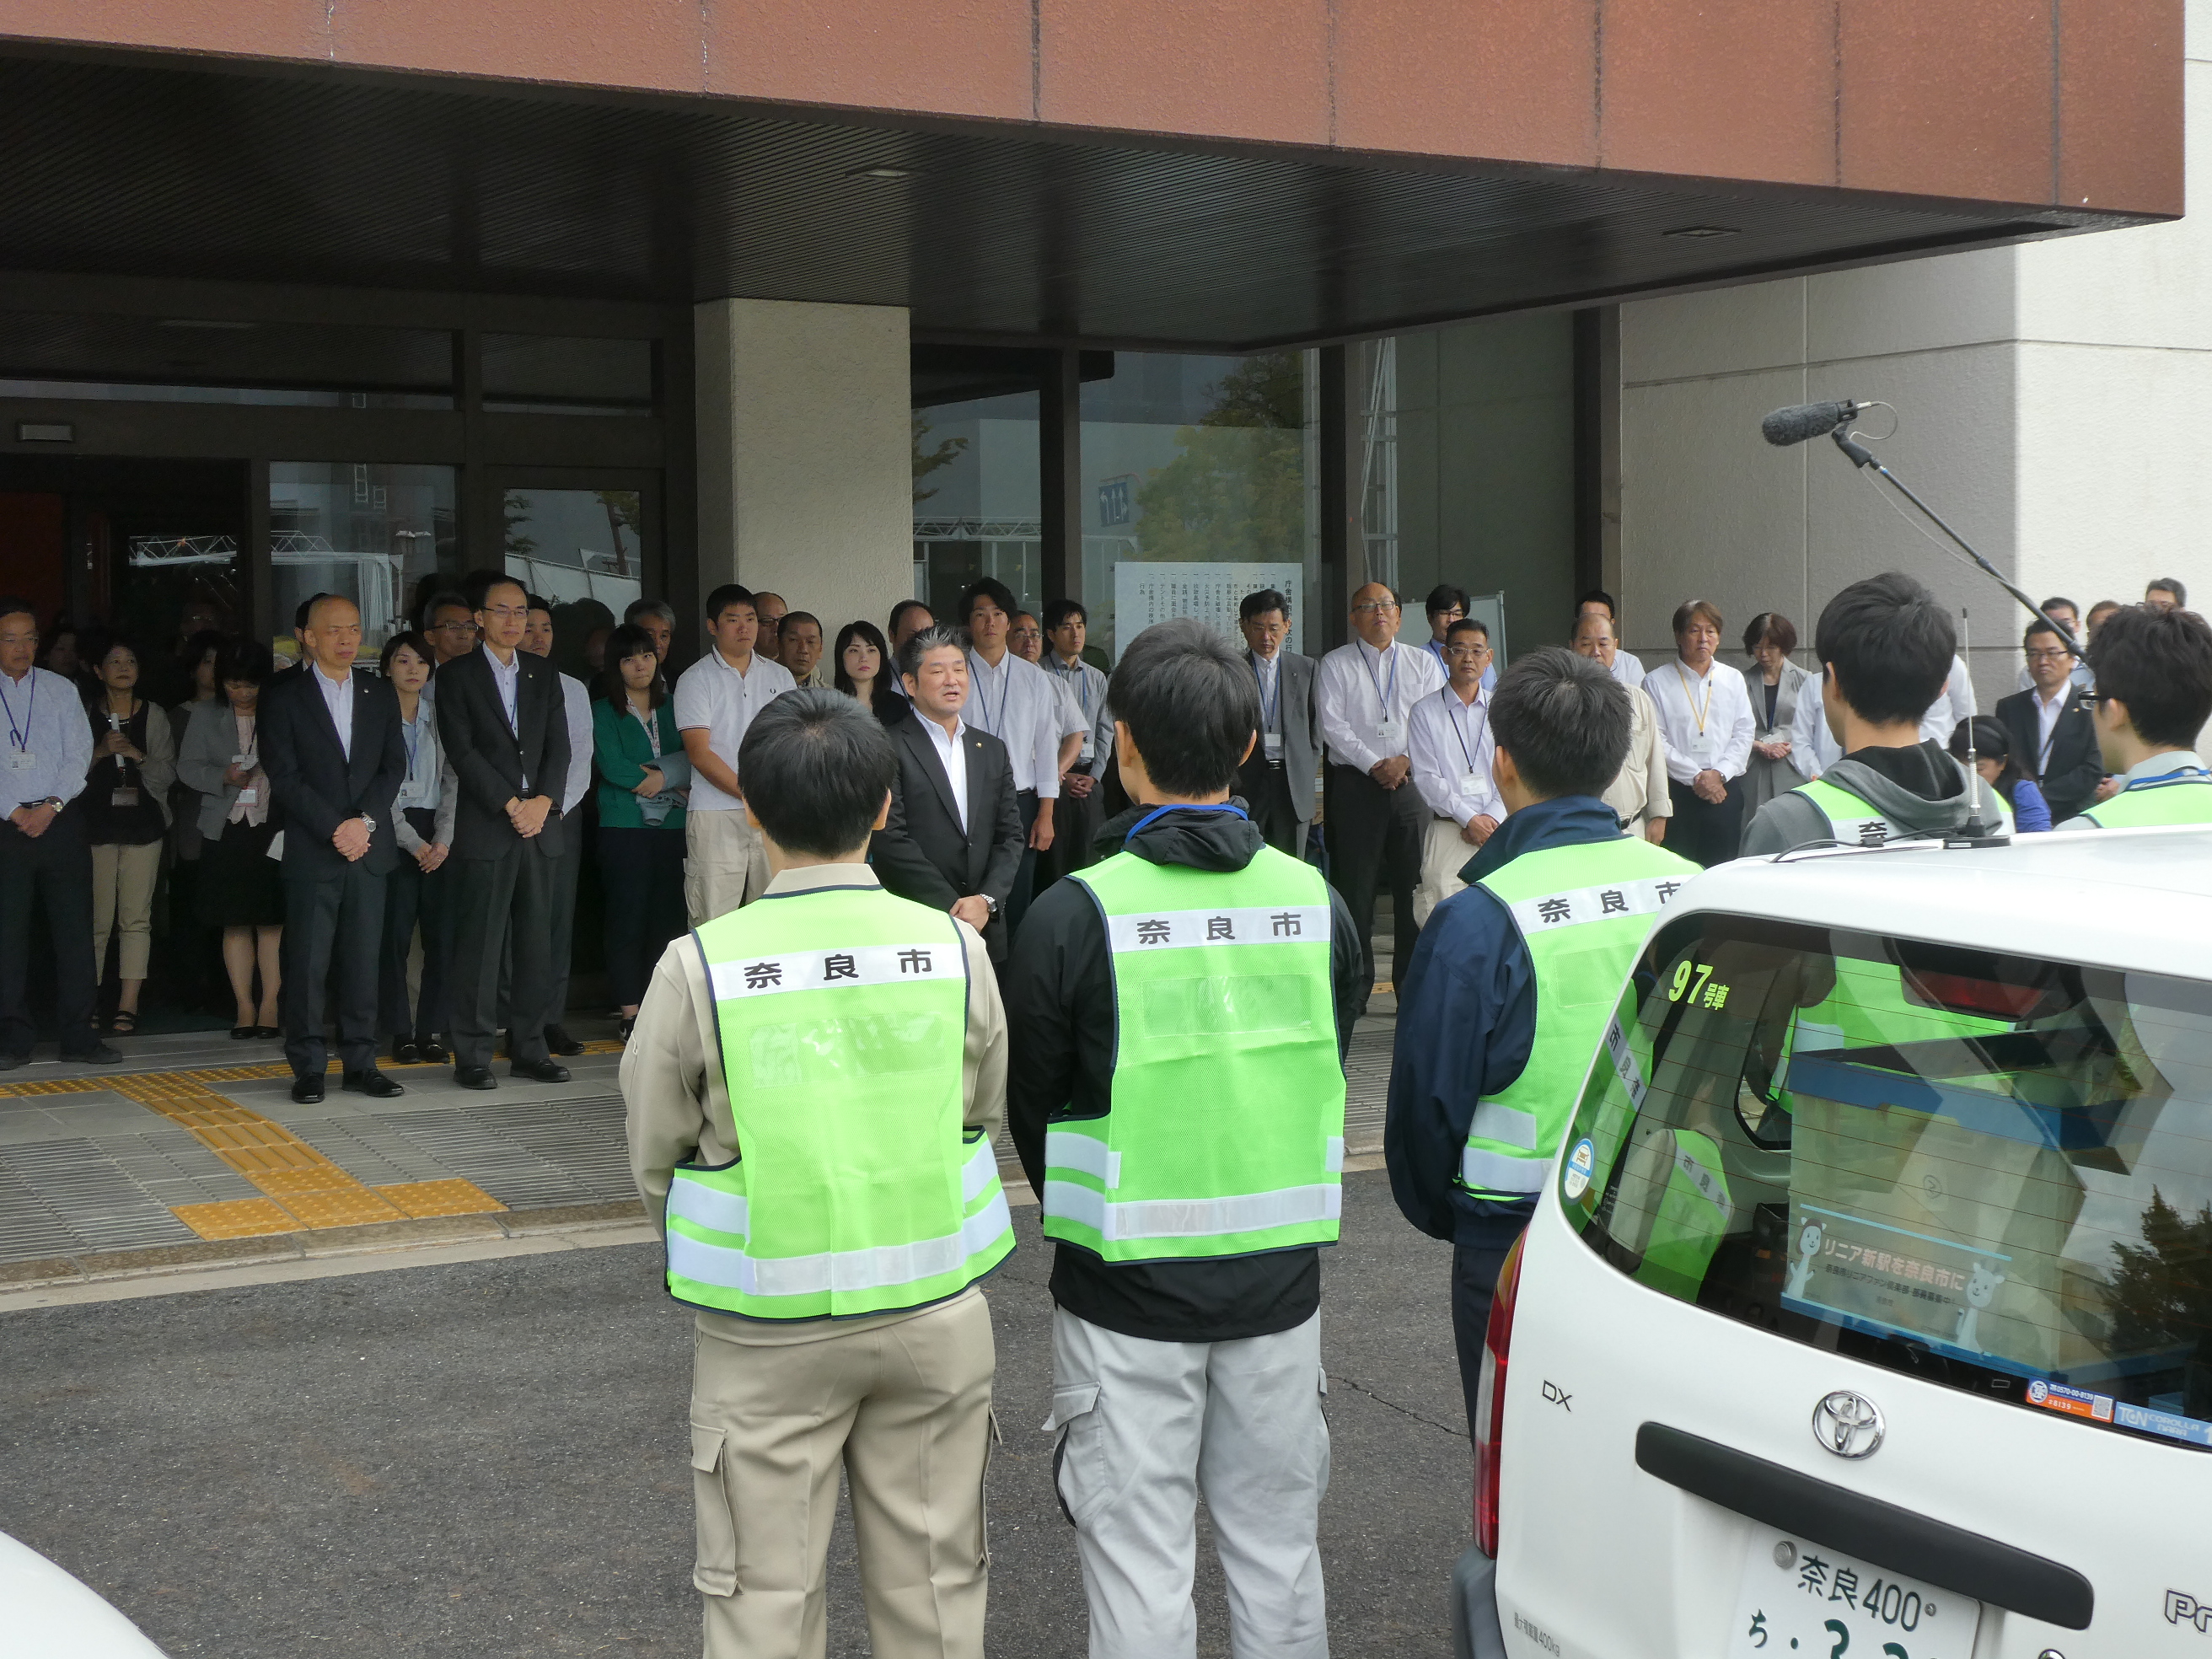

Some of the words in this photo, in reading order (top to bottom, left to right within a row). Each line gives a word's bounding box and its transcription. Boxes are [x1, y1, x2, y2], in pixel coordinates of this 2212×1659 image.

[1136, 912, 1302, 945] 奈良市
[744, 948, 932, 990] 奈良市
[1668, 959, 1730, 1011] 97号車
[1824, 1238, 1968, 1291] リニア新駅を奈良市に
[1542, 1379, 1572, 1413] DX
[2048, 1399, 2072, 1409] #8139
[2149, 1414, 2200, 1431] COROLLA
[1797, 1555, 1922, 1632] 奈良400
[1748, 1608, 1768, 1648] ち
